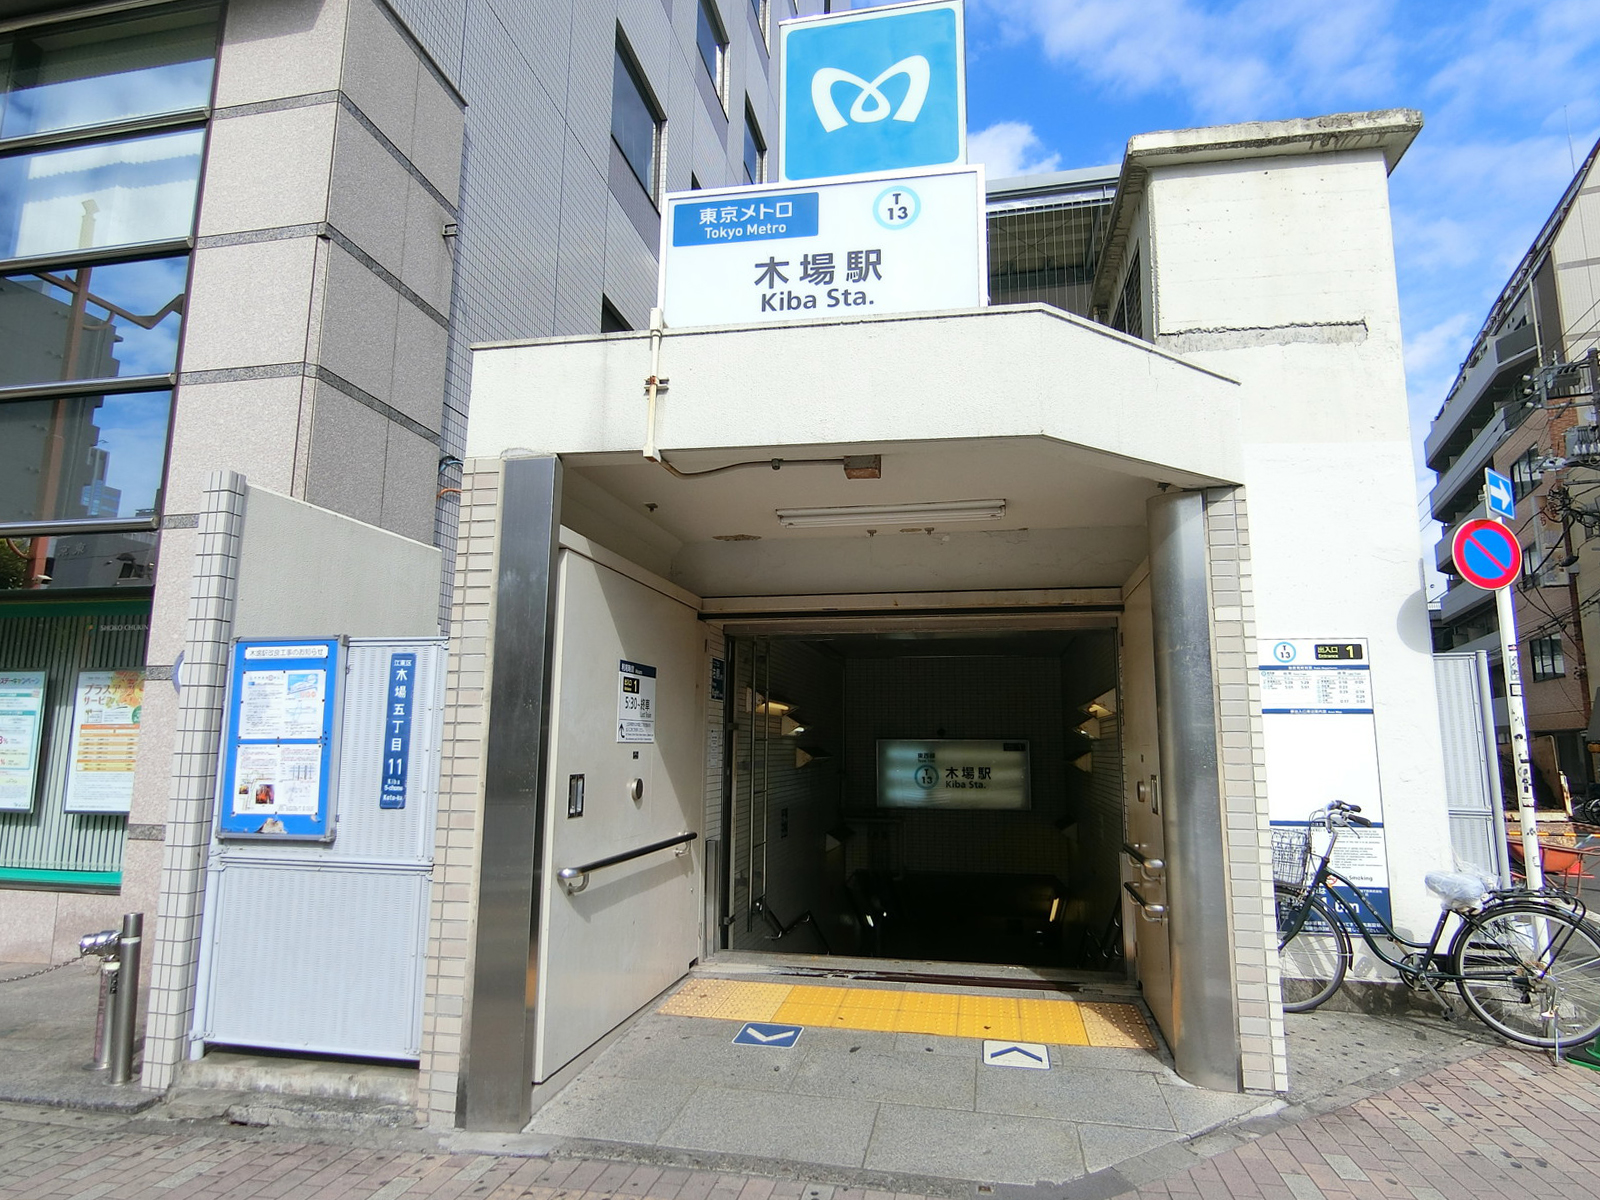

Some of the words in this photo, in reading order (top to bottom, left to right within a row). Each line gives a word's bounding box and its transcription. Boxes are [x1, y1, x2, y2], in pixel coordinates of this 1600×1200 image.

[892, 193, 902, 205] T
[699, 202, 793, 225] 東京メトロ
[887, 206, 909, 220] 13
[704, 226, 743, 239] Tokyo
[747, 223, 787, 235] Metro
[754, 249, 882, 289] 木場駅
[761, 290, 817, 312] Kiba
[827, 288, 875, 308] Sta.
[1280, 651, 1291, 659] 13
[1345, 645, 1354, 658] 1
[391, 668, 408, 751] 木場五丁目
[388, 758, 403, 775] 11
[945, 767, 991, 780] 木場駅
[945, 781, 966, 789] Kiba
[969, 781, 987, 789] Sta.
